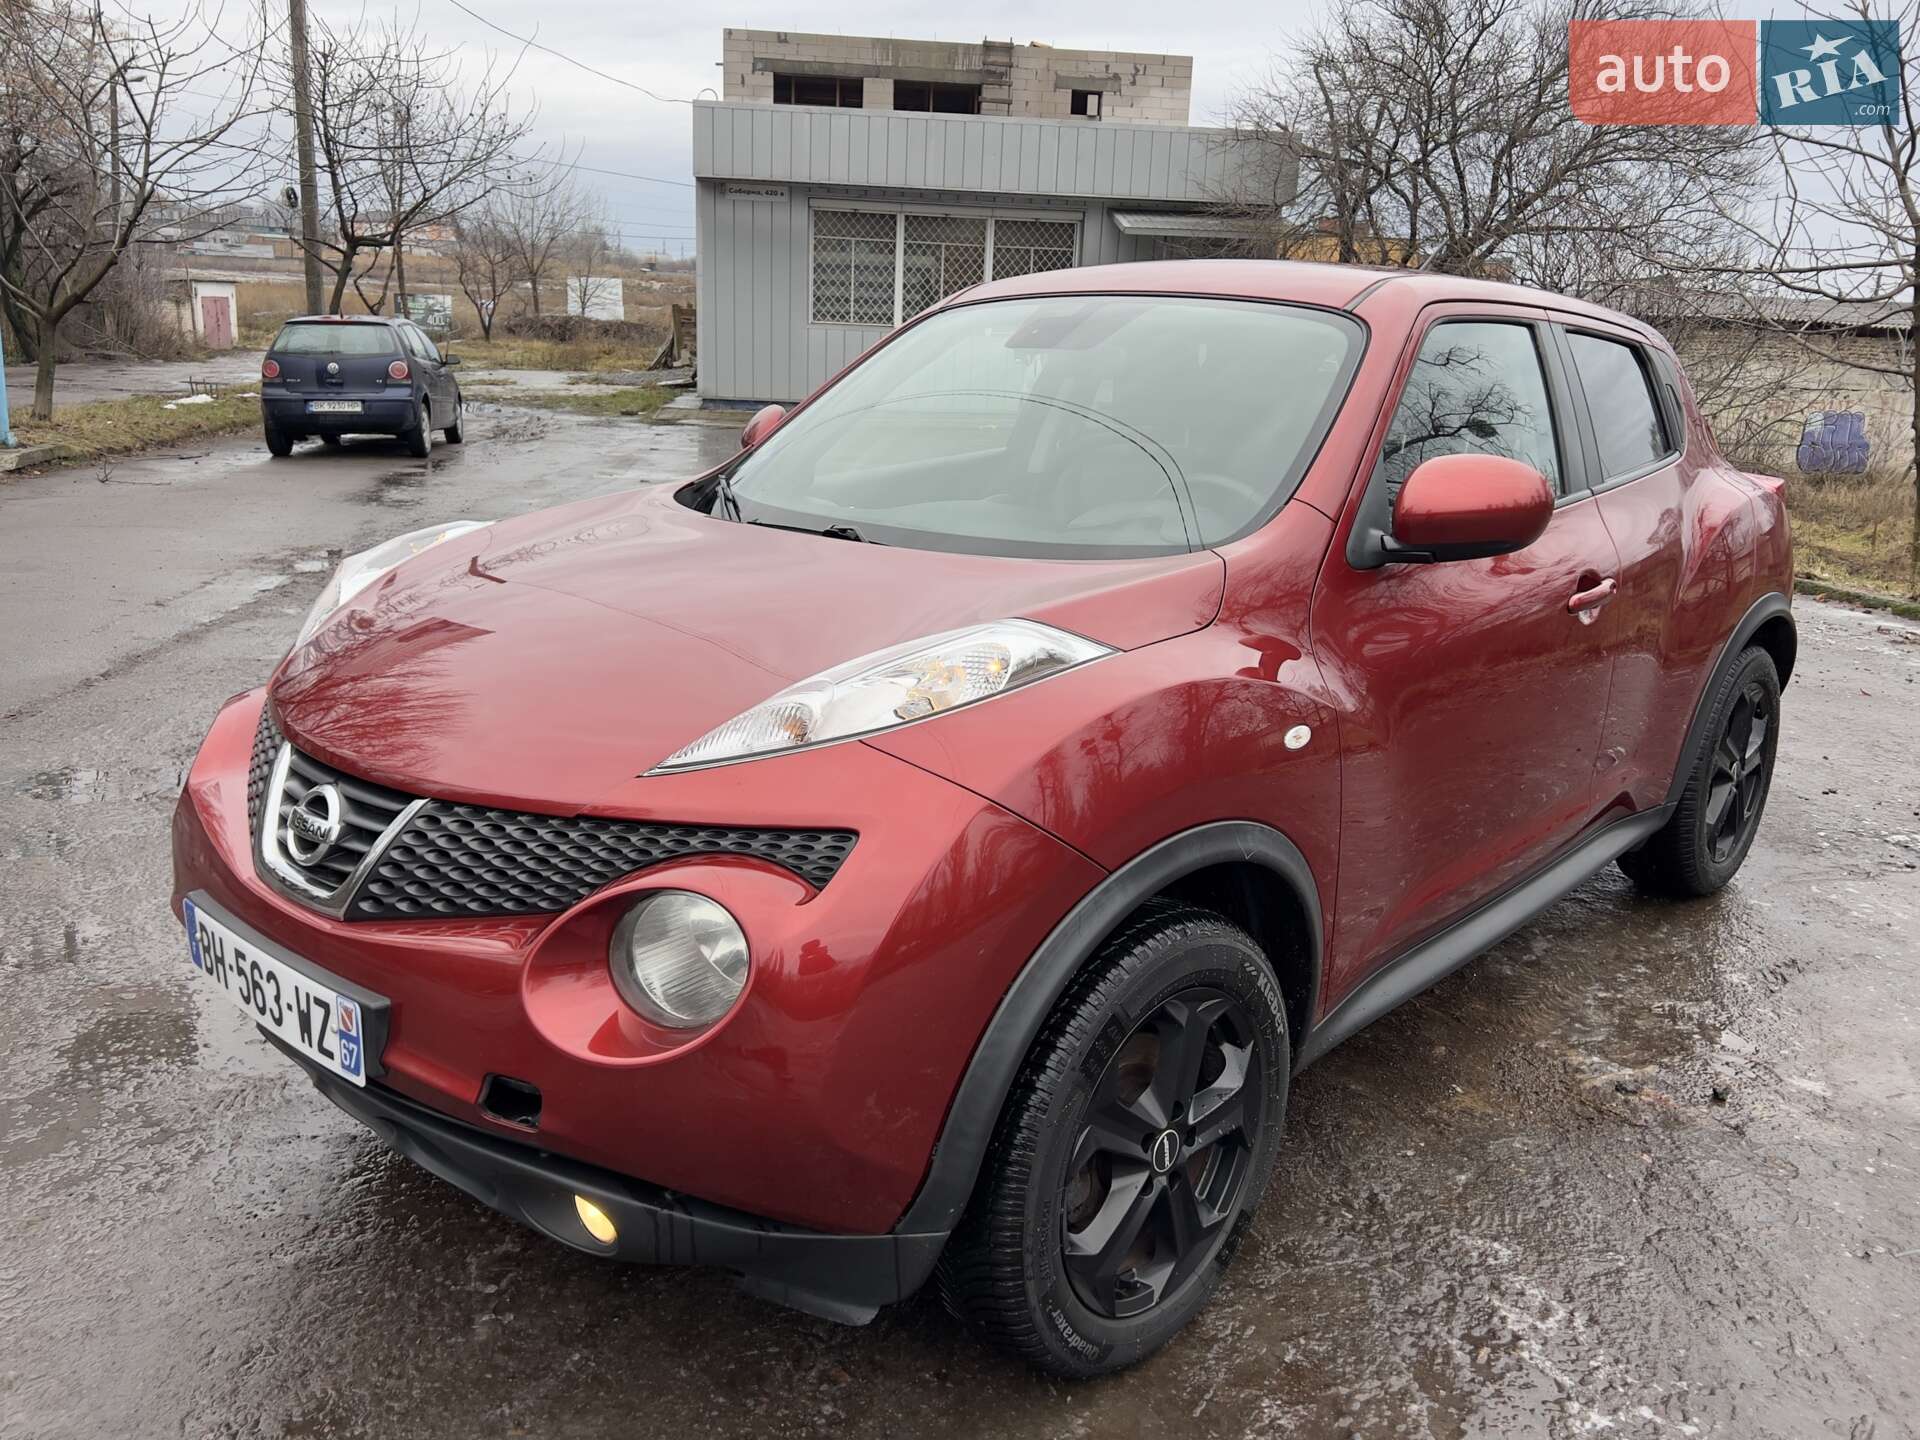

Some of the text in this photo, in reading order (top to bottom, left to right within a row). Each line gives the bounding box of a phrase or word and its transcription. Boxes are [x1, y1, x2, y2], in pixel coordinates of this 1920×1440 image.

[199, 921, 335, 1061] BH-563-WZ
[1257, 971, 1284, 1035] Kleber
[340, 1038, 358, 1069] 67
[1051, 1308, 1101, 1360] Quadraxer
